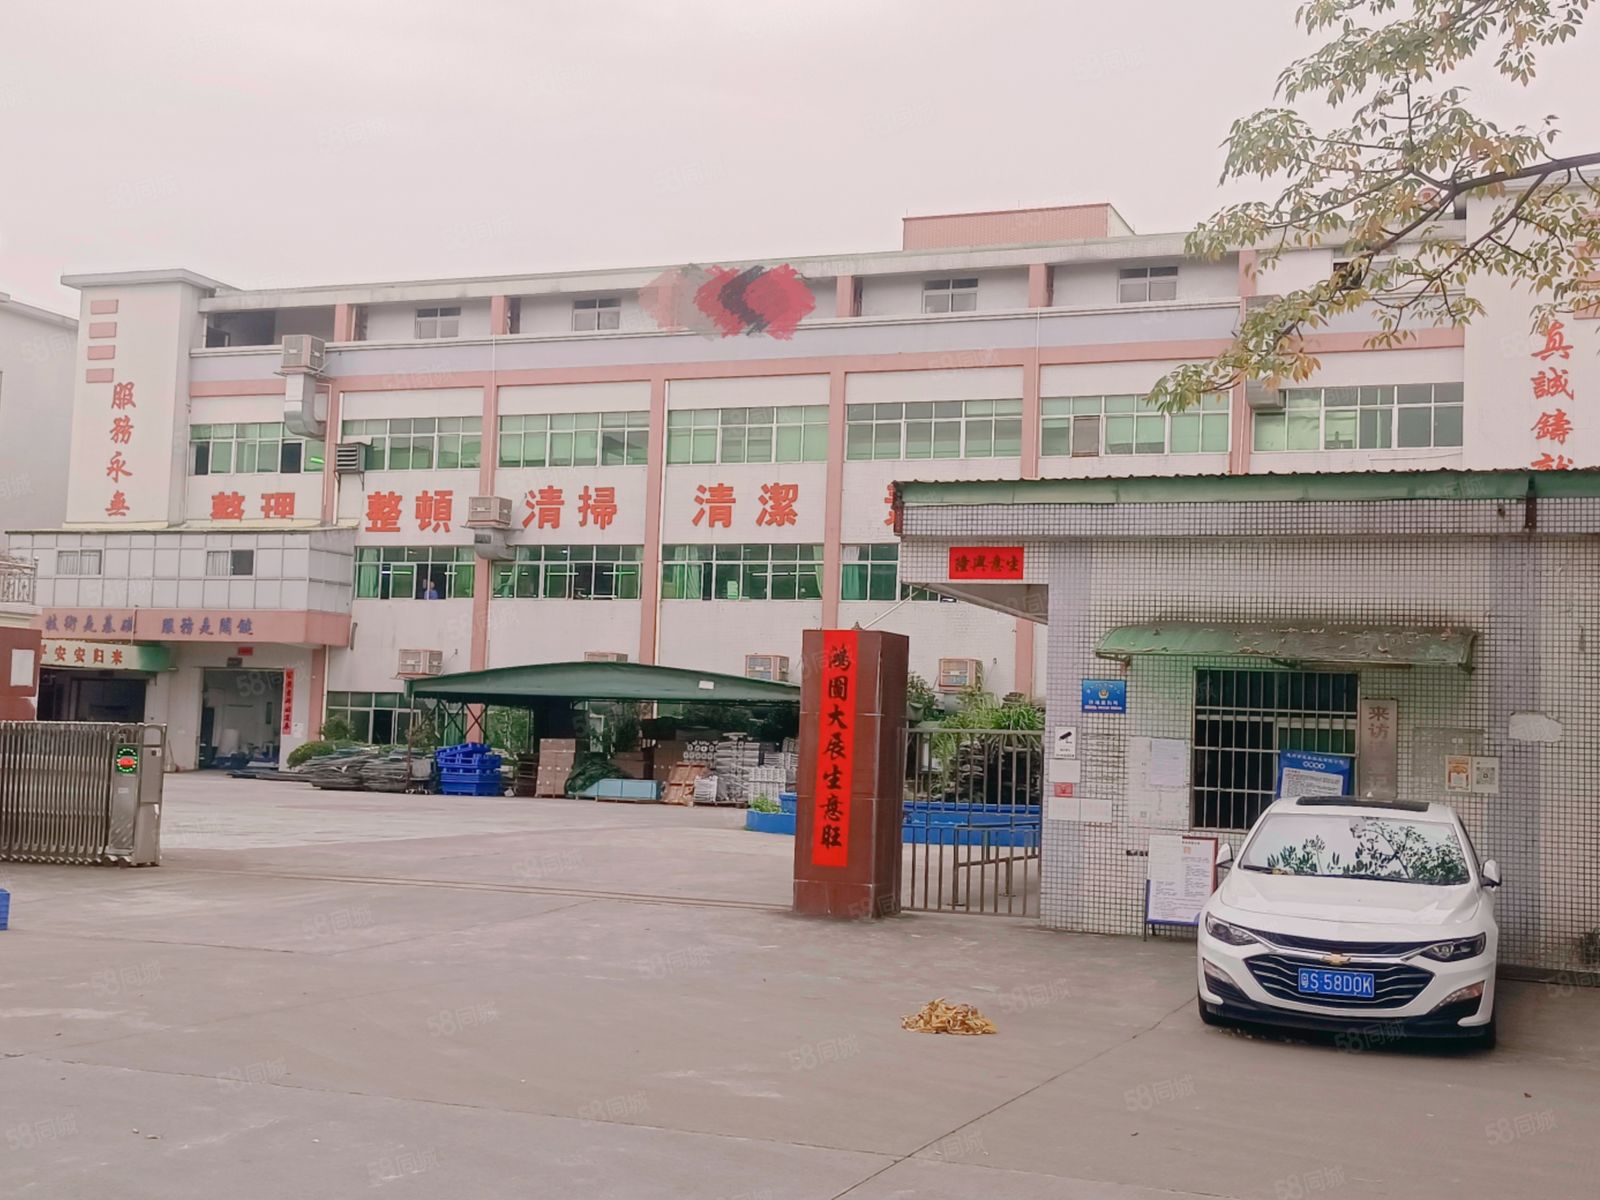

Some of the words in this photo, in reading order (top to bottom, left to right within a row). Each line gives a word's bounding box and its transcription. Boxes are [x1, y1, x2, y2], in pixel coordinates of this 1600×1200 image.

[365, 490, 453, 533] 整頓
[522, 484, 618, 530] 清掃
[692, 482, 799, 529] 清潔
[819, 642, 852, 849] 鴻圖大展生意旺
